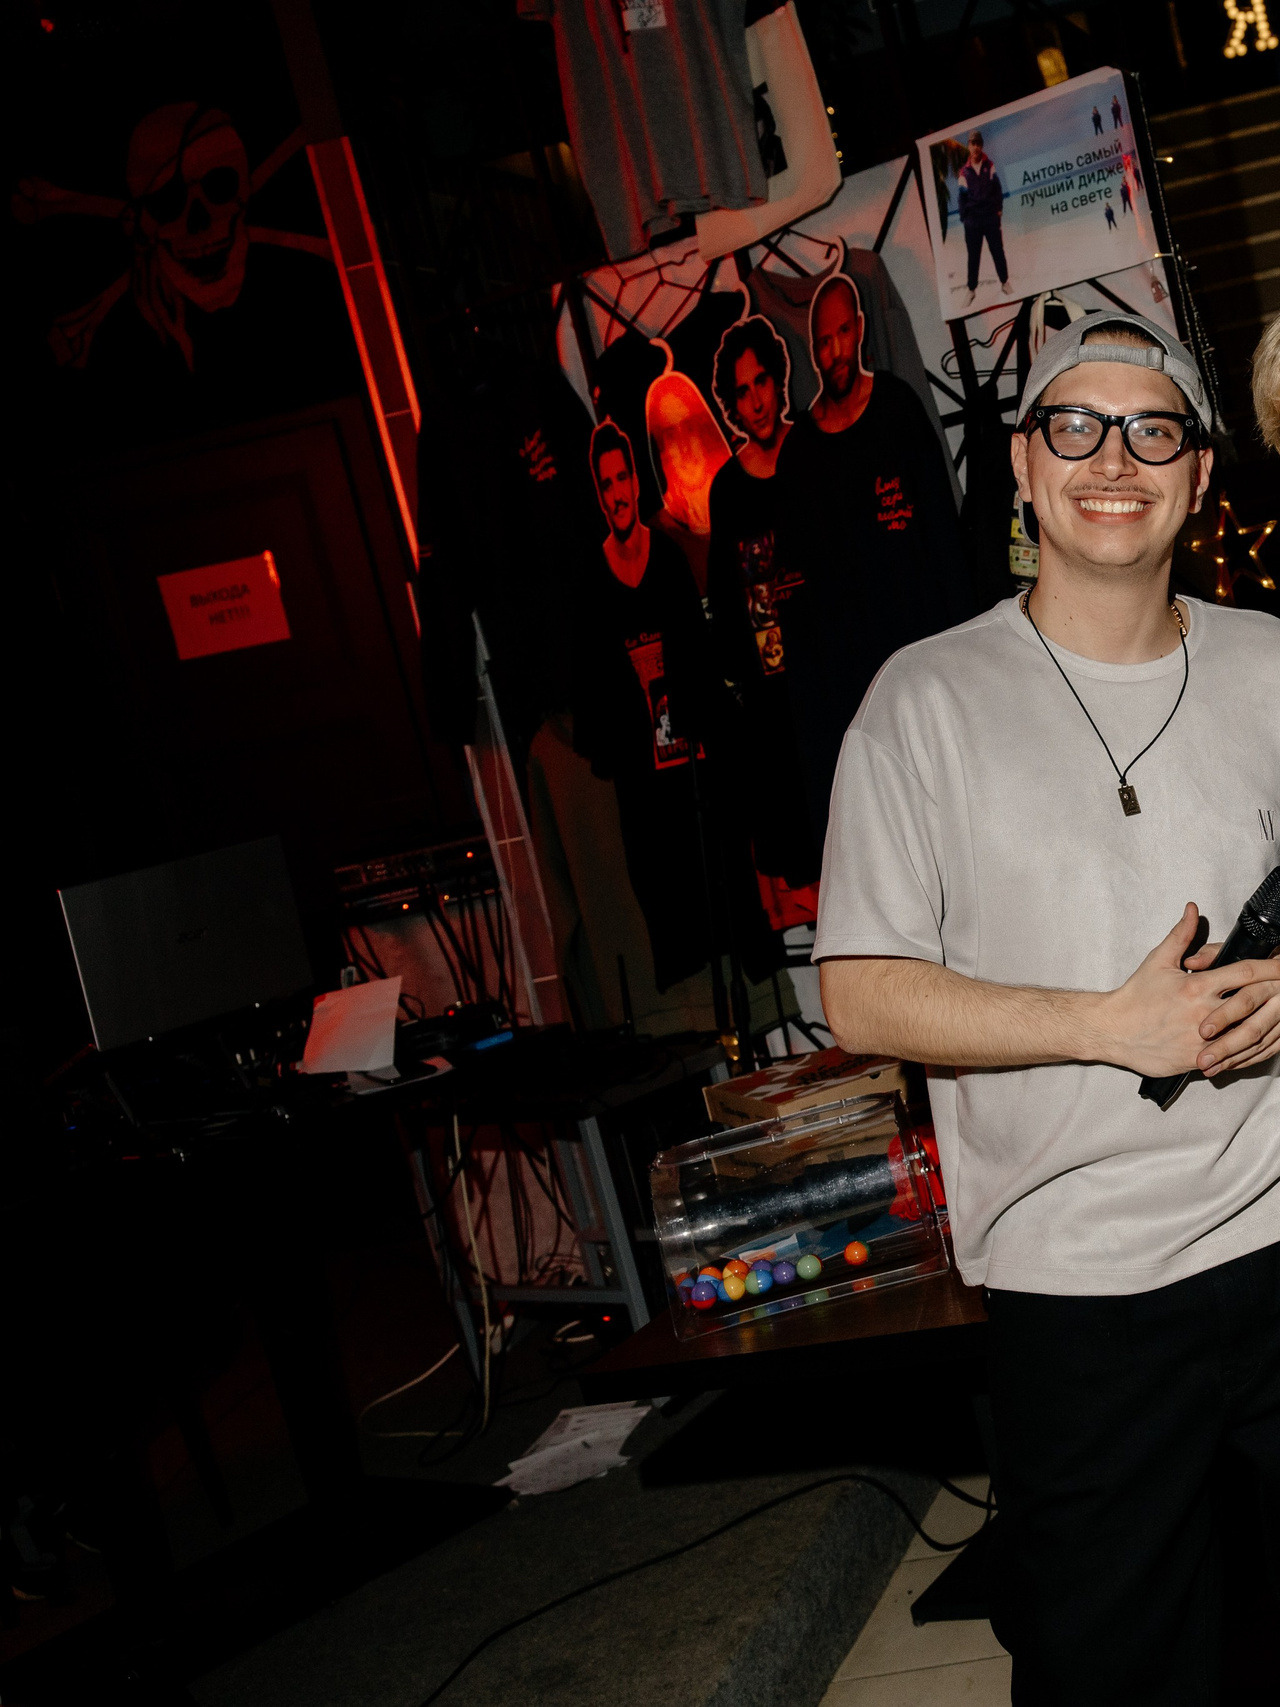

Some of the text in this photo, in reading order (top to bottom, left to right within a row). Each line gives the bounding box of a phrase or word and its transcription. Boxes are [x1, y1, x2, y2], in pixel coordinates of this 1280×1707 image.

[1022, 138, 1123, 186] Антонь самый
[1020, 175, 1075, 206] лучший
[1050, 186, 1113, 216] на свете
